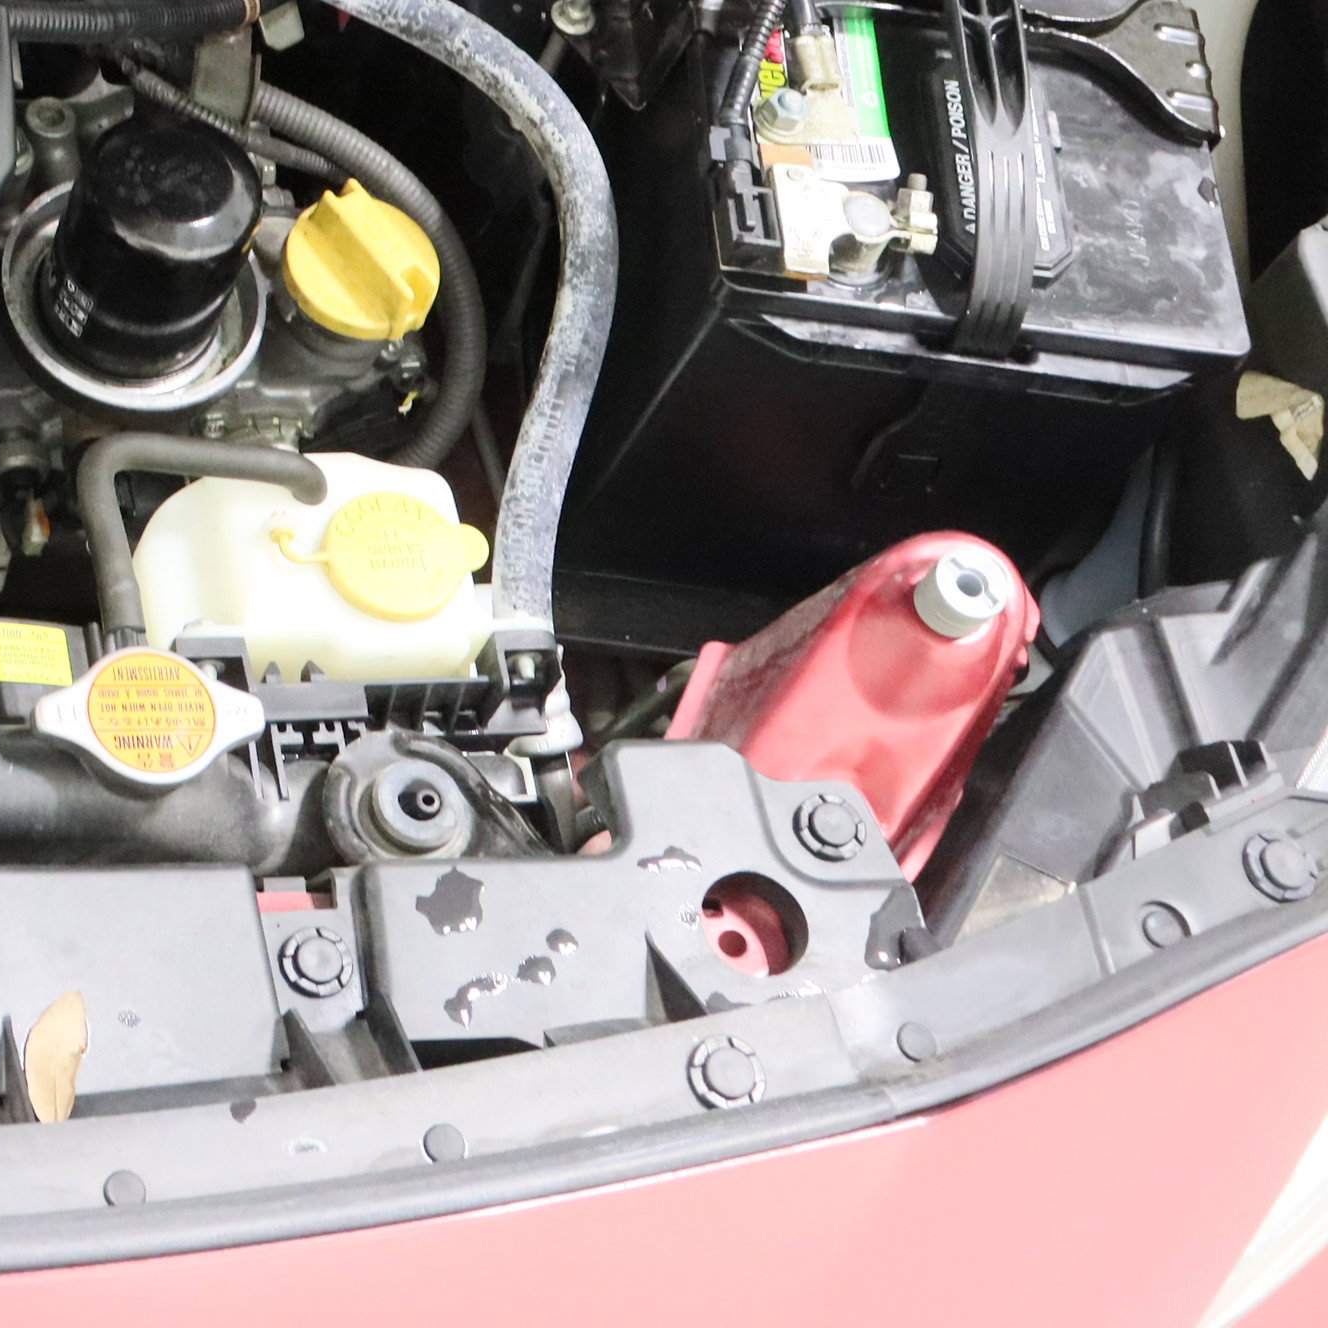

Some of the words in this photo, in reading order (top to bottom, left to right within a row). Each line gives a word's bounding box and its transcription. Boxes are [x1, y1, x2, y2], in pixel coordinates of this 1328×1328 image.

[945, 80, 967, 139] POISON
[955, 153, 976, 221] DANGER
[334, 496, 446, 536] COOLANT
[120, 702, 146, 713] WHEN
[149, 702, 174, 713] OPEN
[178, 702, 205, 713] NEVER
[113, 734, 174, 751] WARNING
